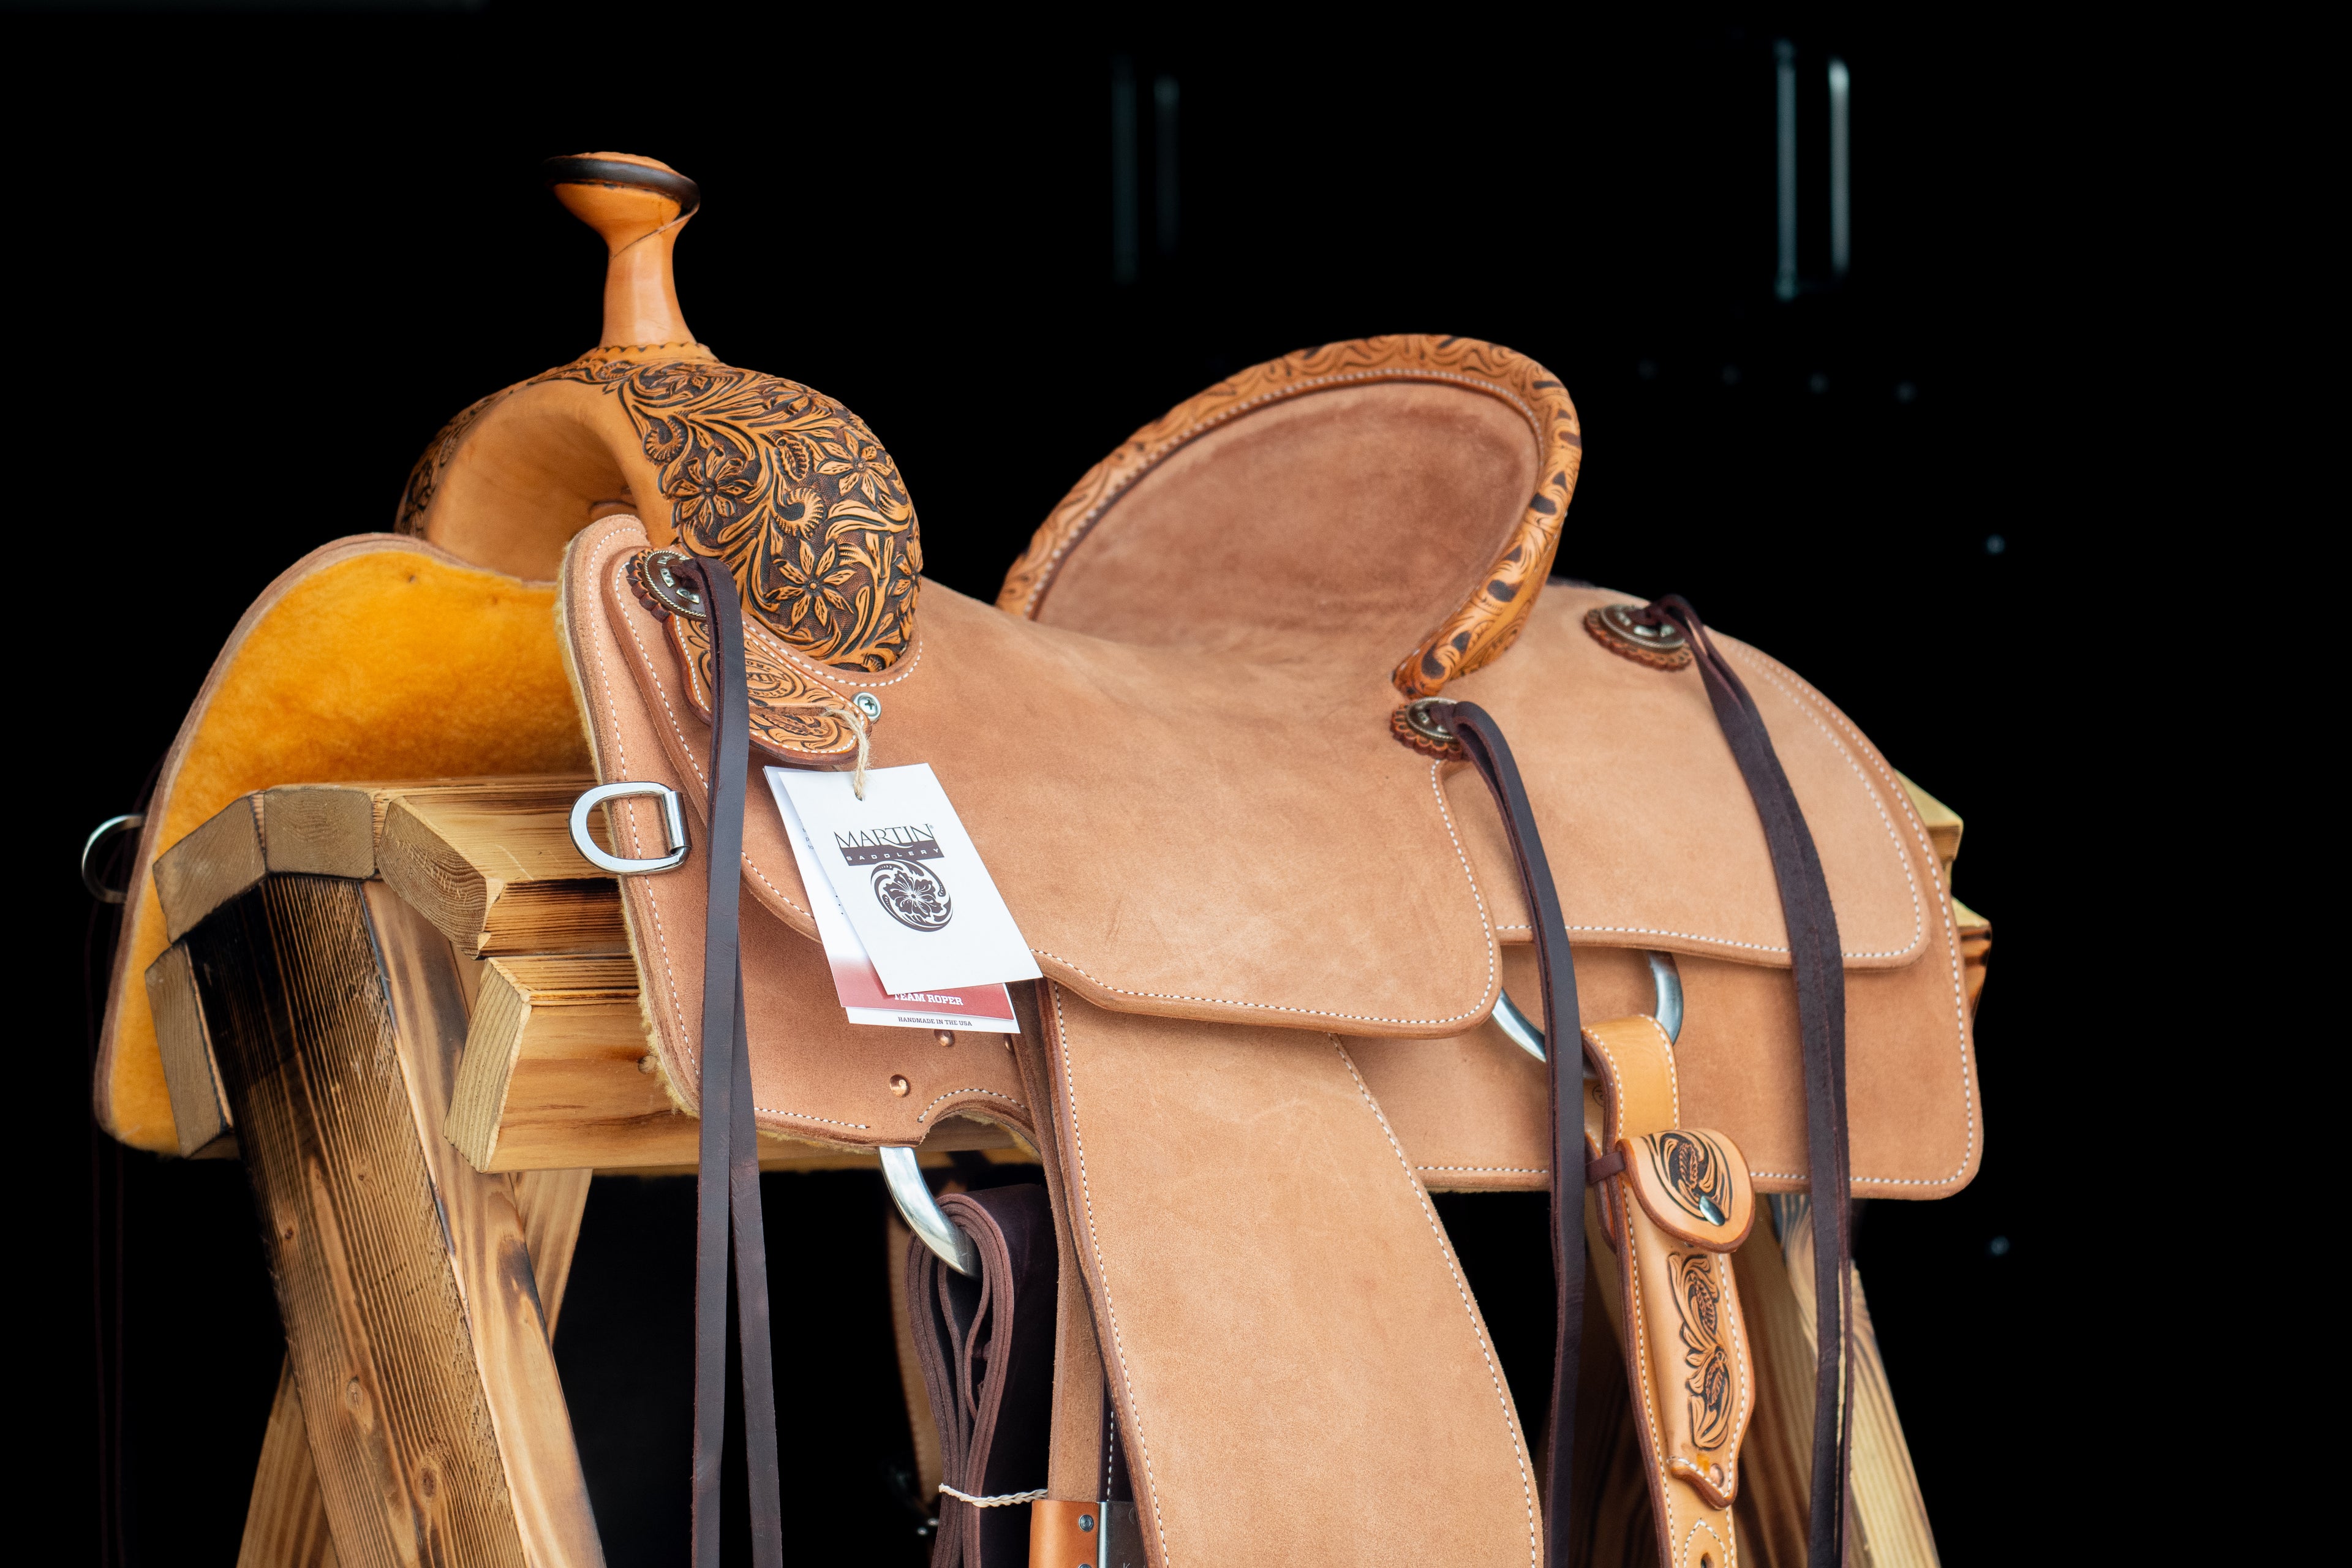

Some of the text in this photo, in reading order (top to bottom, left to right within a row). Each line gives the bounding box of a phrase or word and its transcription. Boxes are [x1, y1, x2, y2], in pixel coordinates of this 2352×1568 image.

[846, 848, 939, 861] SADDLERY
[894, 992, 964, 1006] TEAM ROPER
